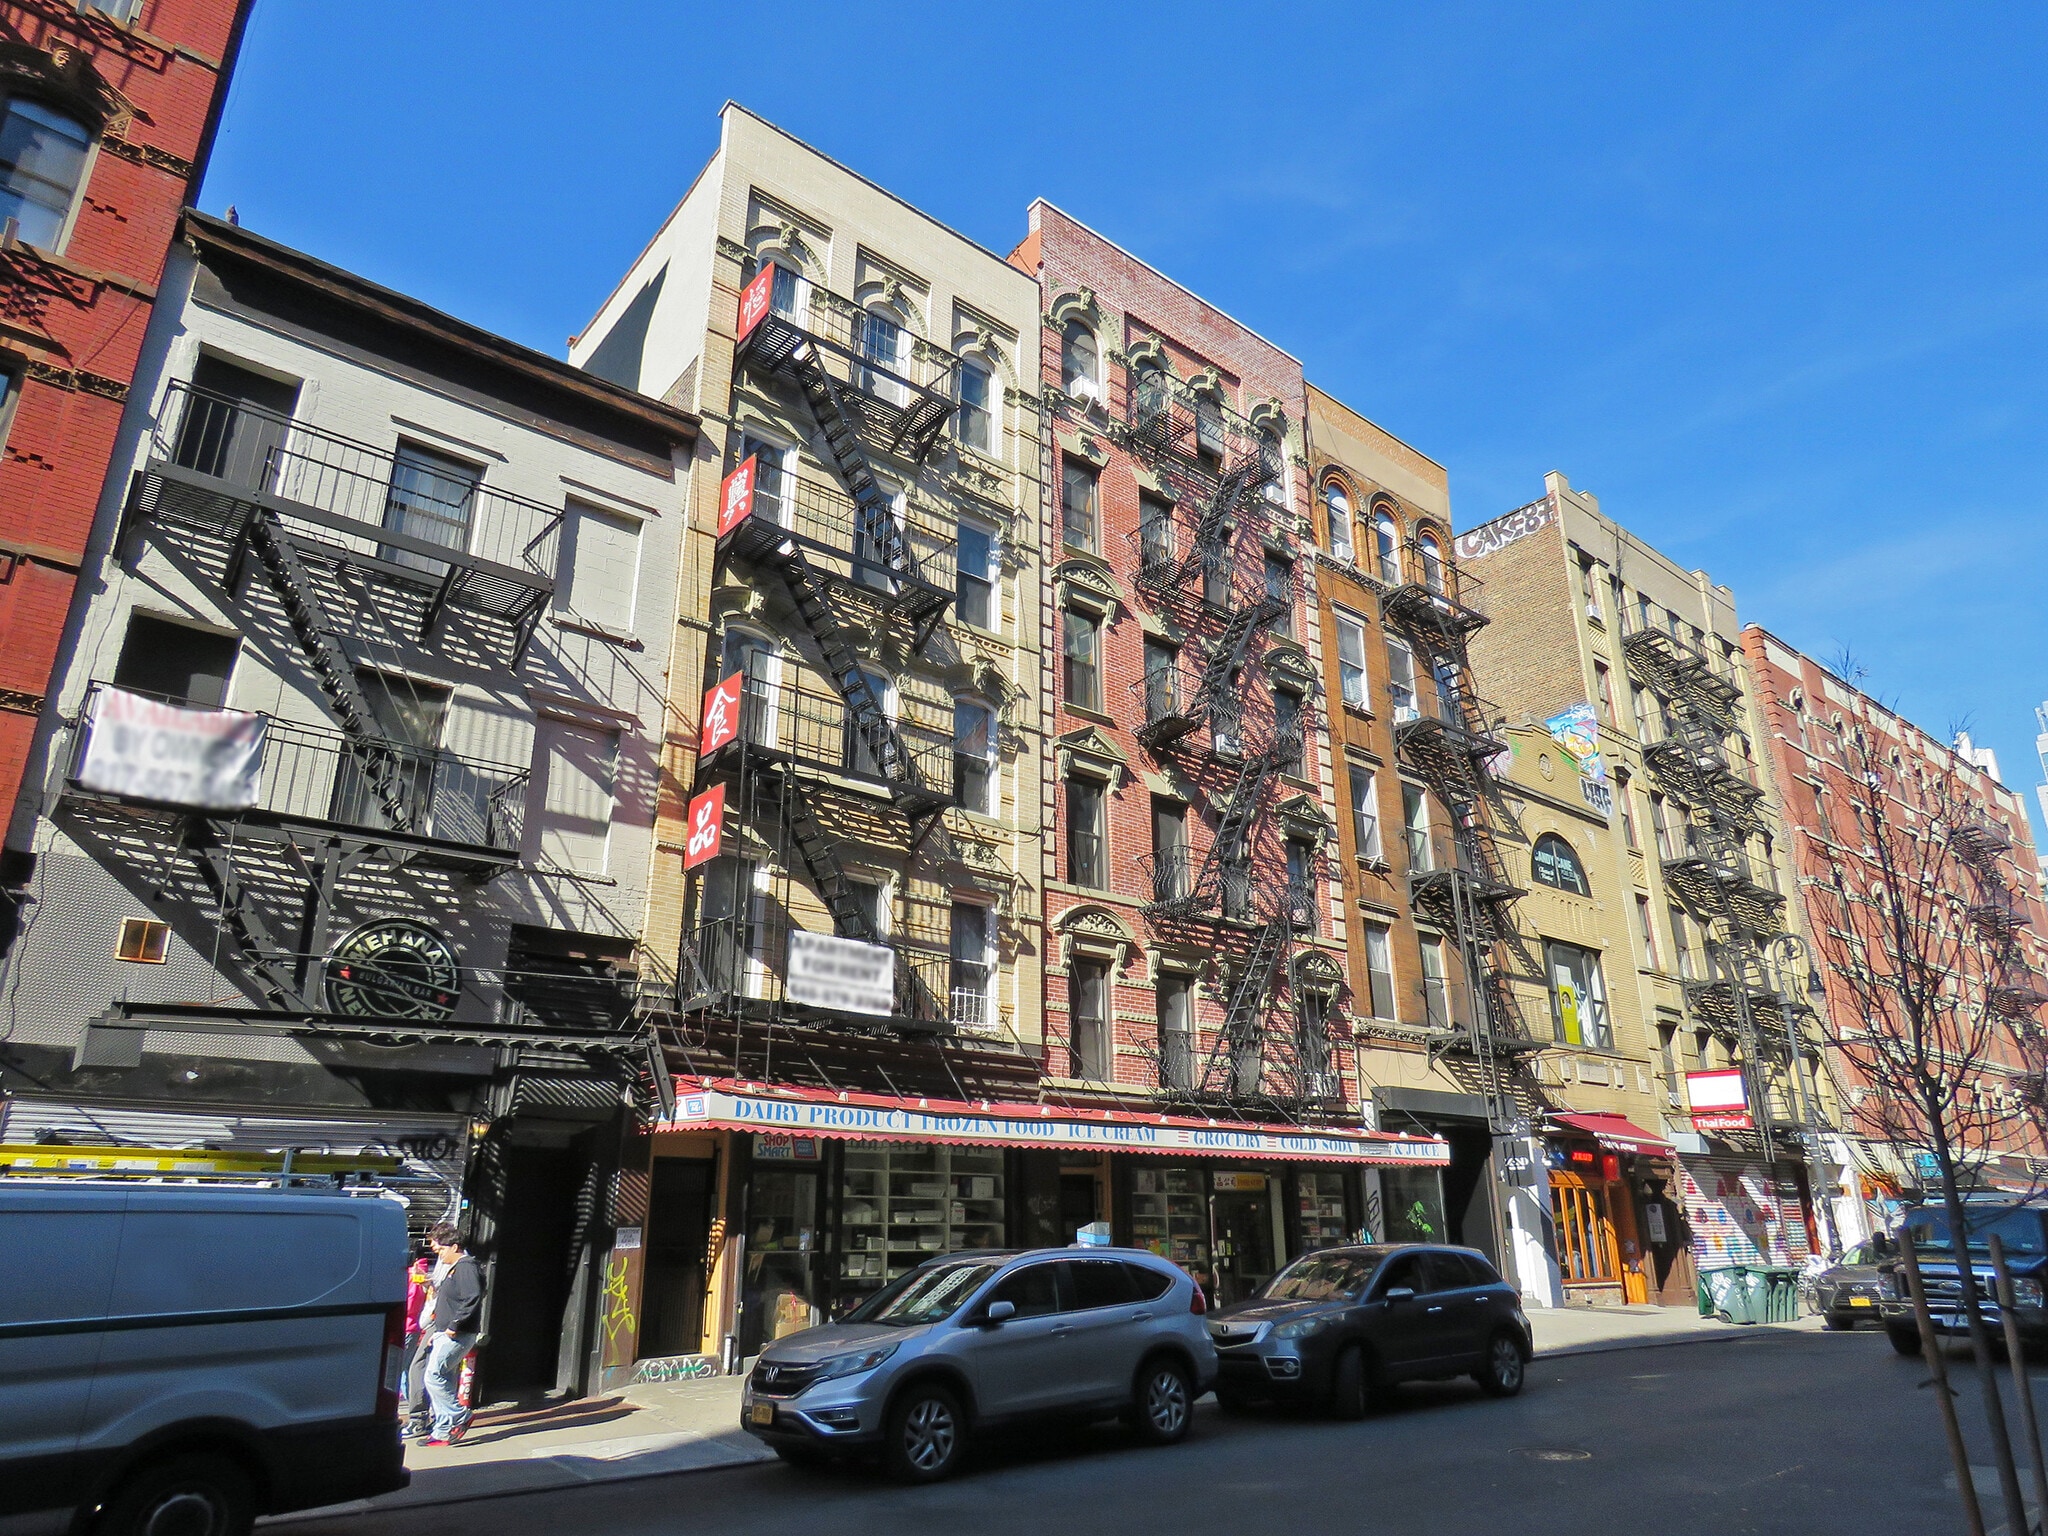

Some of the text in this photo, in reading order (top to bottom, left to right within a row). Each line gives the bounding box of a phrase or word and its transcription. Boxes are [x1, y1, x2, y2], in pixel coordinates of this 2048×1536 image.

[705, 686, 737, 747] 食
[688, 800, 717, 857] 品
[347, 929, 451, 986] MEHANATA
[412, 984, 432, 998] BAR
[734, 1099, 803, 1123] DAIRY
[809, 1106, 914, 1130] PRODUCT
[921, 1116, 1000, 1135] FROZEN
[1003, 1121, 1055, 1138] FOOD
[1067, 1124, 1097, 1139] ICE
[1102, 1127, 1157, 1143] CREAM
[1193, 1131, 1263, 1149] GROCERY
[1280, 1137, 1318, 1151] COLD
[1321, 1139, 1355, 1154] SODA
[1394, 1144, 1403, 1155] &
[1405, 1143, 1440, 1157] JUICE
[1695, 1117, 1746, 1128] Thai Food
[757, 1143, 792, 1158] SMART
[763, 1135, 789, 1147] SHOP
